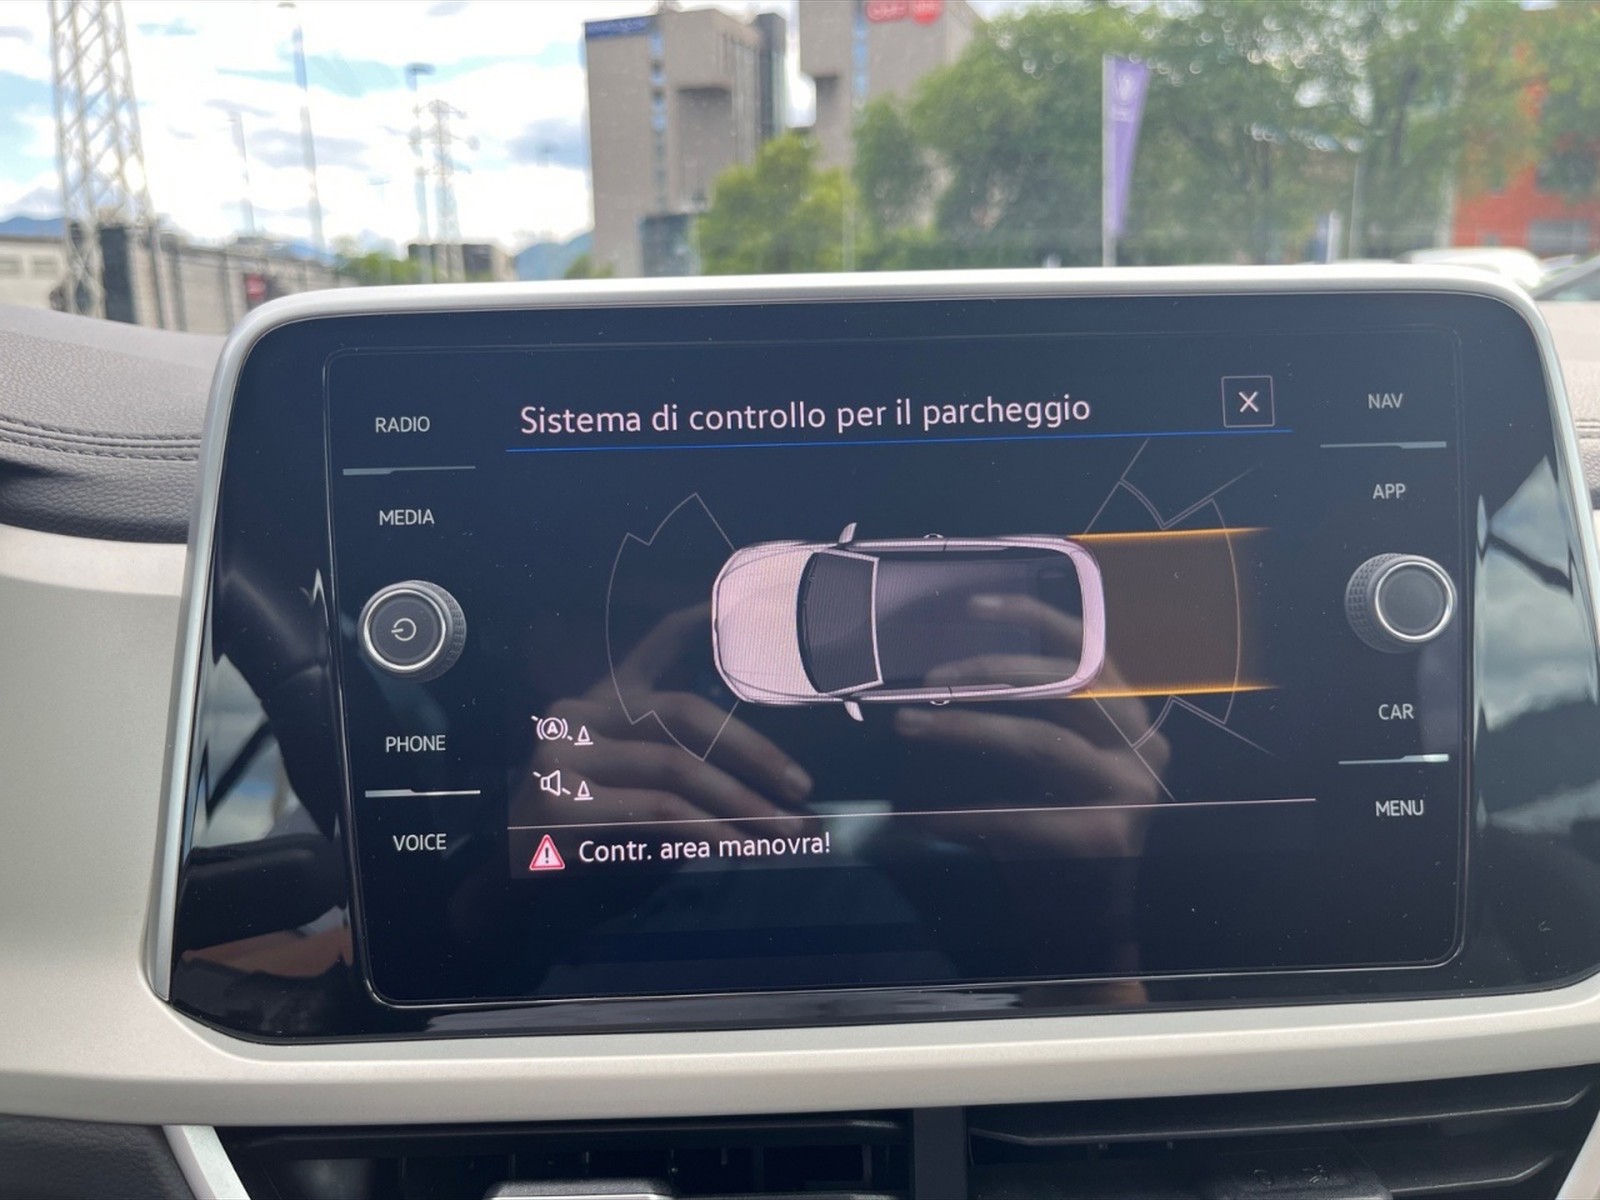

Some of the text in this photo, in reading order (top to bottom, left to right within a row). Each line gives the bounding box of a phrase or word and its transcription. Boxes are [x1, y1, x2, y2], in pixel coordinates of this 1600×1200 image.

[1367, 392, 1404, 409] NAV
[520, 393, 1091, 434] Sistema di controllo per il parcheggio
[375, 415, 431, 433] RADIO
[1372, 482, 1406, 500] APP
[379, 508, 435, 526] MEDIA
[1378, 703, 1415, 721] CAR
[385, 734, 446, 753] PHONE
[1375, 799, 1424, 817] MENU
[392, 833, 447, 852] VOICE
[578, 831, 830, 863] Contr. area manovra!
